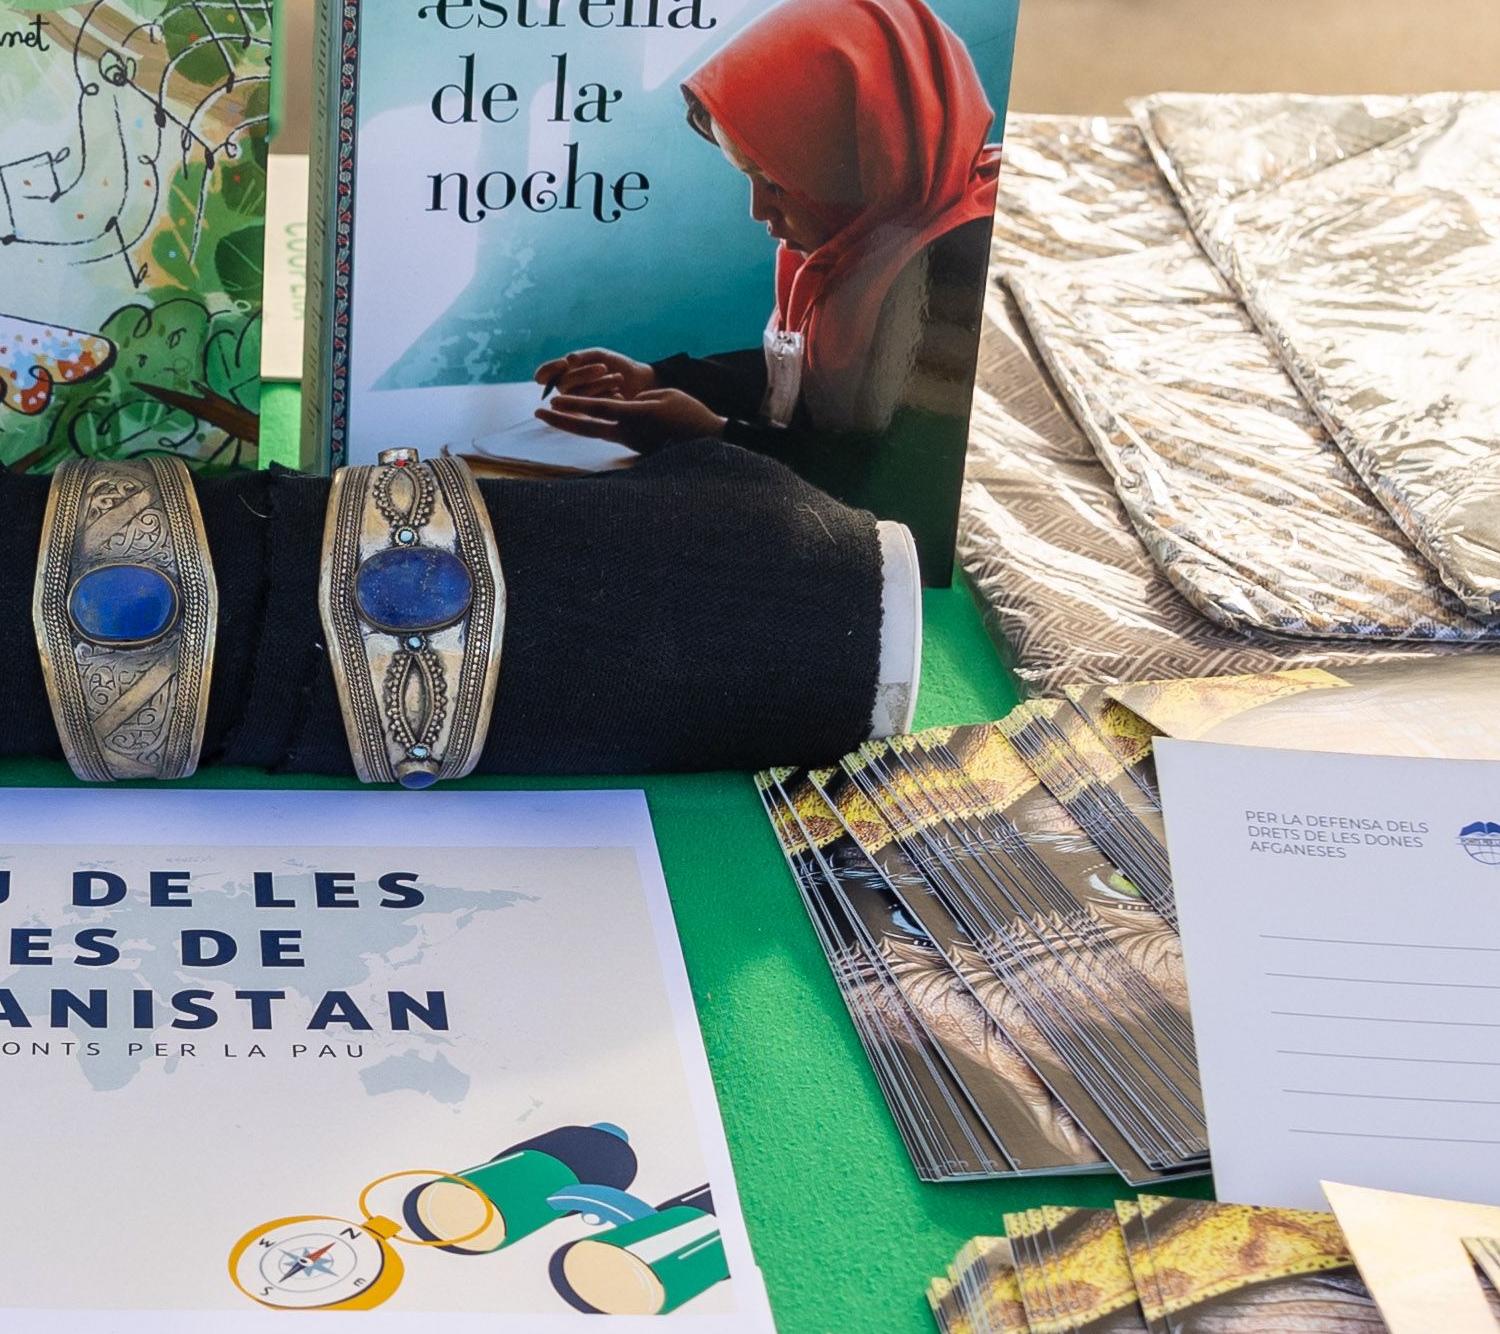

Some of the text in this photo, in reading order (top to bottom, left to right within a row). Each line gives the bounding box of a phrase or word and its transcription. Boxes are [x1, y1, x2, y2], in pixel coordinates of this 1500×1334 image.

[429, 52, 623, 125] de la
[423, 142, 651, 224] noche
[1245, 810, 1429, 833] PER LA DEFENSA DELS
[1247, 825, 1423, 848] DRETS DE LES DONES
[1250, 841, 1346, 858] AFGANESES
[72, 870, 192, 907] DE
[253, 871, 424, 909] LES
[180, 929, 305, 967] DE
[128, 1042, 195, 1057] PER
[224, 1044, 266, 1058] LA
[292, 1044, 363, 1058] PAU
